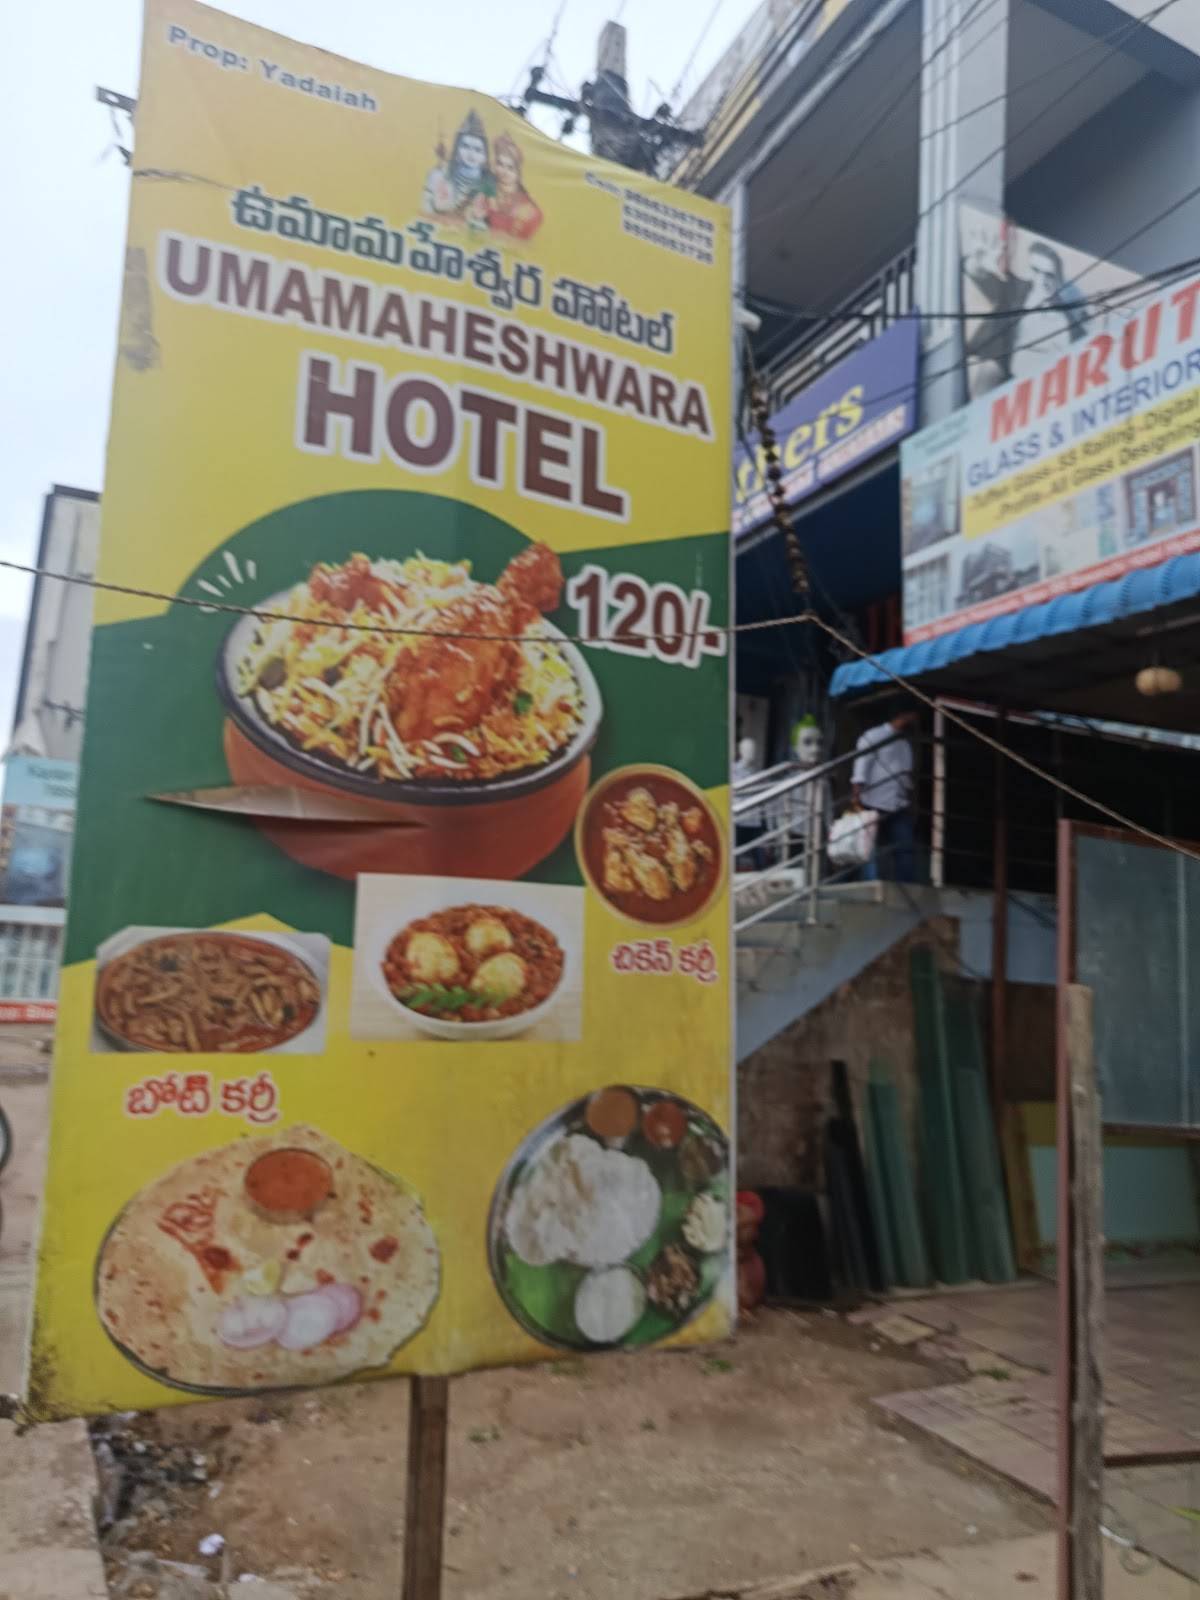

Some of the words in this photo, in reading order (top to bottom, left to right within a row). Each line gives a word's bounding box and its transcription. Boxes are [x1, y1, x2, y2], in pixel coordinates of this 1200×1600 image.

[167, 25, 248, 69] Prop:
[259, 59, 378, 112] Yadaiah
[231, 185, 542, 310] ఉమామహేశ్వర
[163, 237, 711, 437] UMAMAHESHWARA
[989, 280, 1200, 443] MARUT
[302, 356, 627, 518] HOTEL
[967, 431, 1042, 487] GLASS
[1049, 420, 1065, 449] &
[571, 570, 721, 662] 120/-
